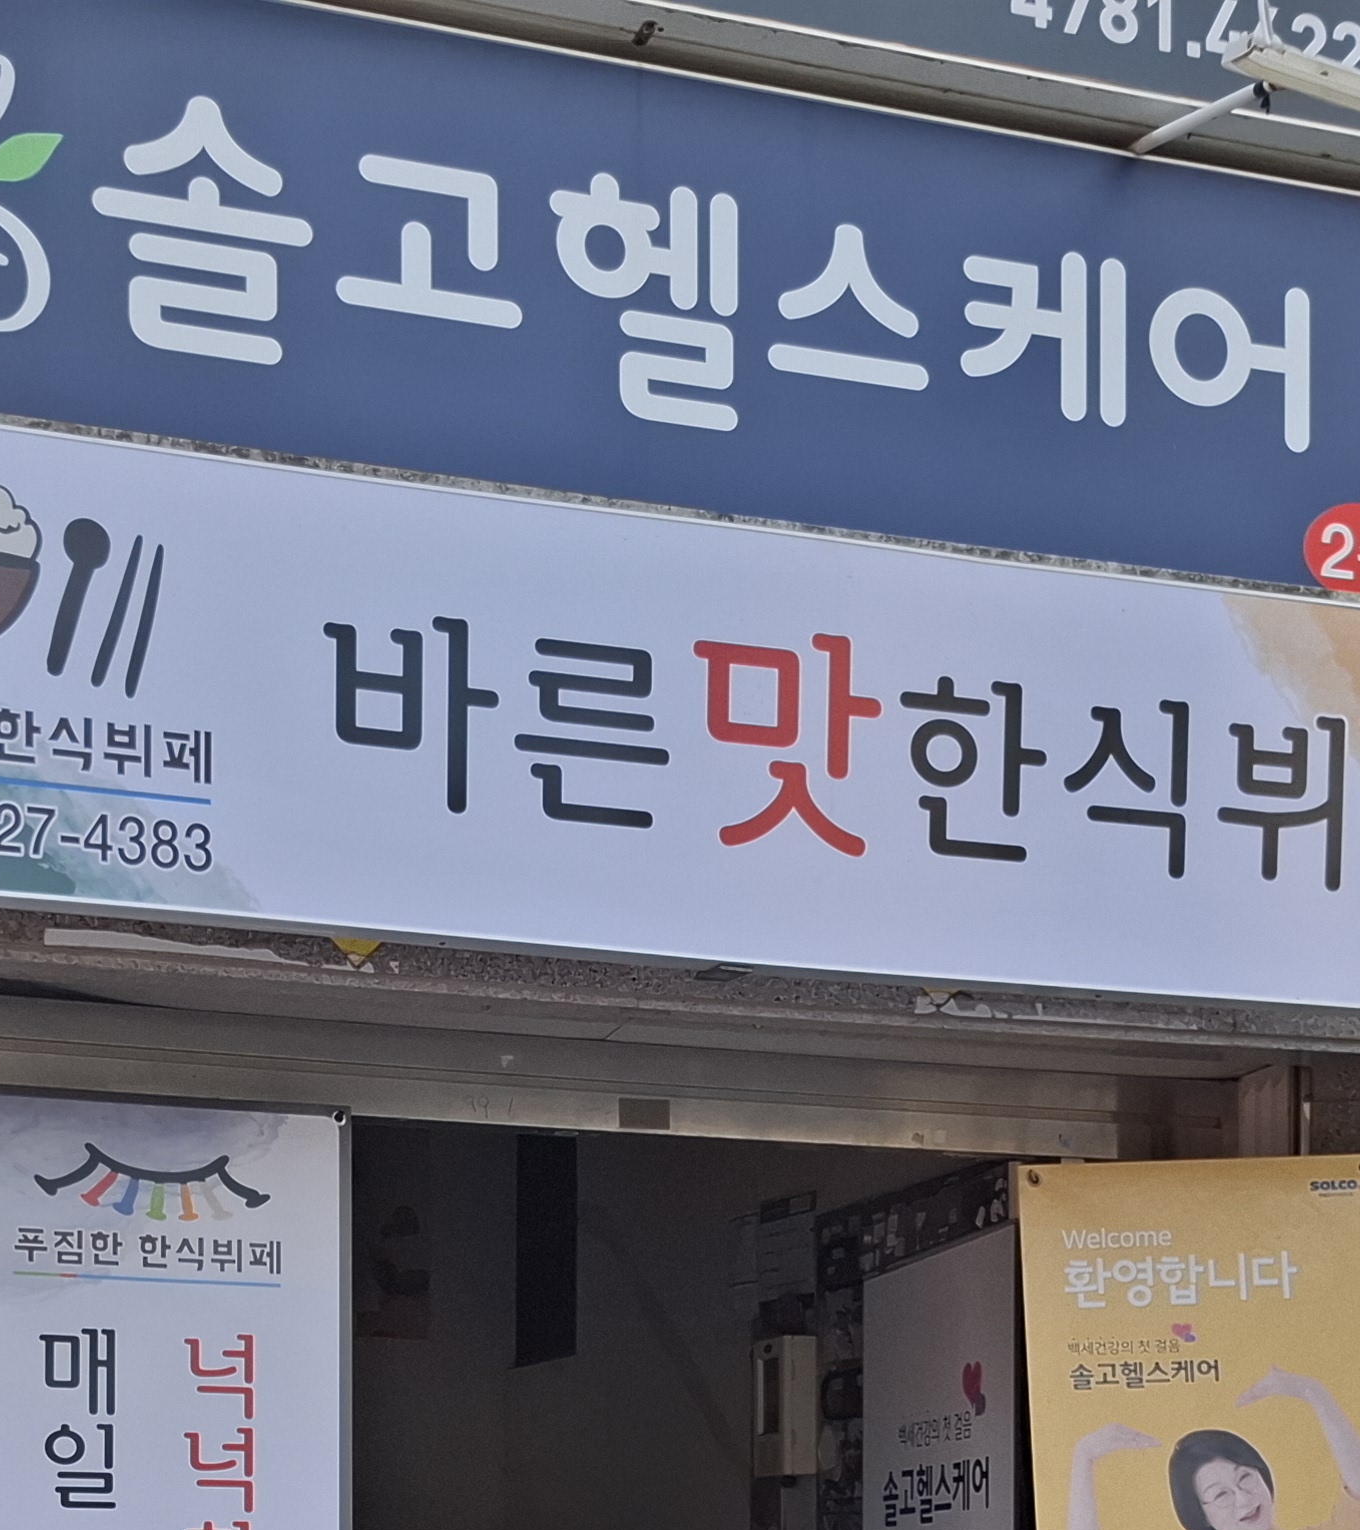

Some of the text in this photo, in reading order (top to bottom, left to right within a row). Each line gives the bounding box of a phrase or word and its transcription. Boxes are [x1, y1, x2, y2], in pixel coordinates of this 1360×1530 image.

[90, 93, 1315, 456] 솔고헬스케어
[13, 1227, 282, 1275] 푸짐한 한식뷔페
[1061, 1228, 1172, 1250] Welcome
[1063, 1250, 1298, 1308] 환영합니다
[1068, 1358, 1220, 1390] 솔고헬스케어
[39, 1328, 117, 1509] 매일
[882, 1456, 990, 1527] 솔고헬스케어
